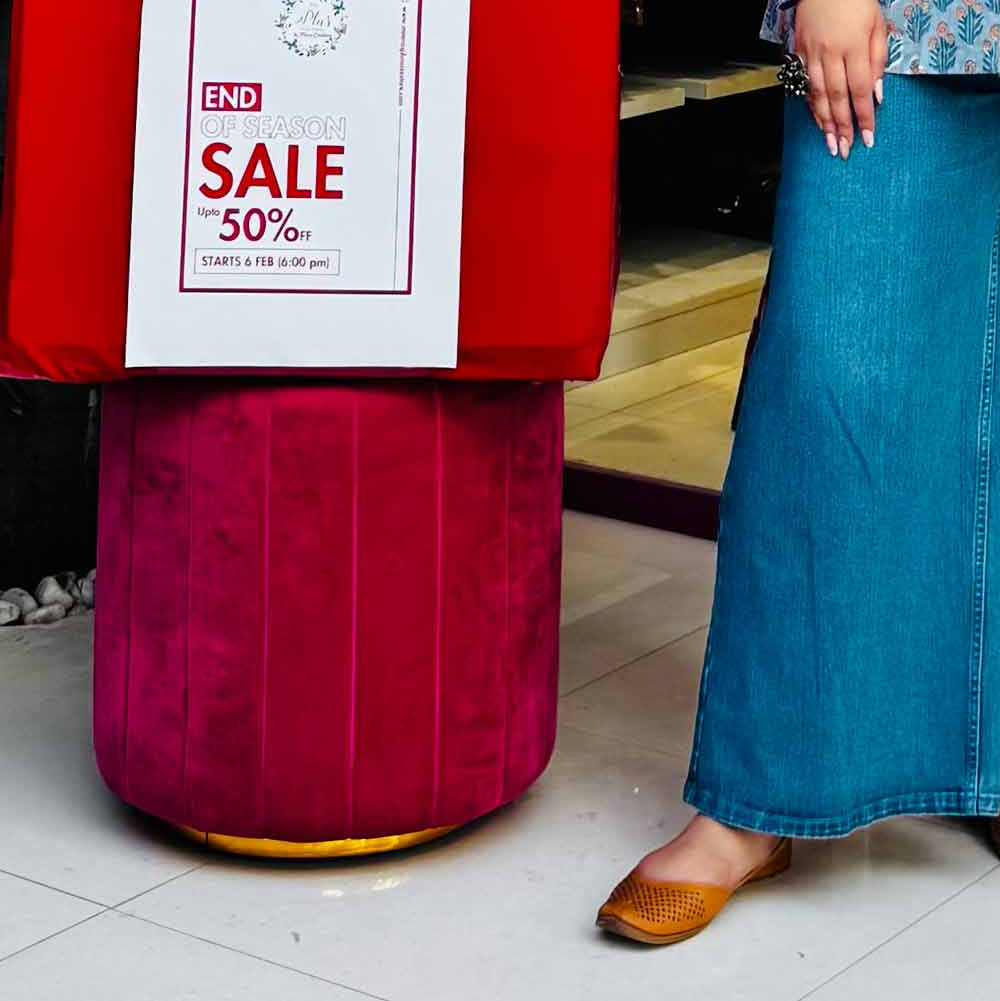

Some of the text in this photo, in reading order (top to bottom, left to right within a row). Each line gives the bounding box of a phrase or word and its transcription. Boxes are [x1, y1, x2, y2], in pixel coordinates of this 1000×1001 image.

[205, 85, 257, 109] END
[200, 114, 346, 140] OF SEASON
[199, 142, 344, 199] SALE
[197, 207, 220, 218] Upto
[201, 255, 330, 269] STARTS 6 FEB (6:00 pm)
